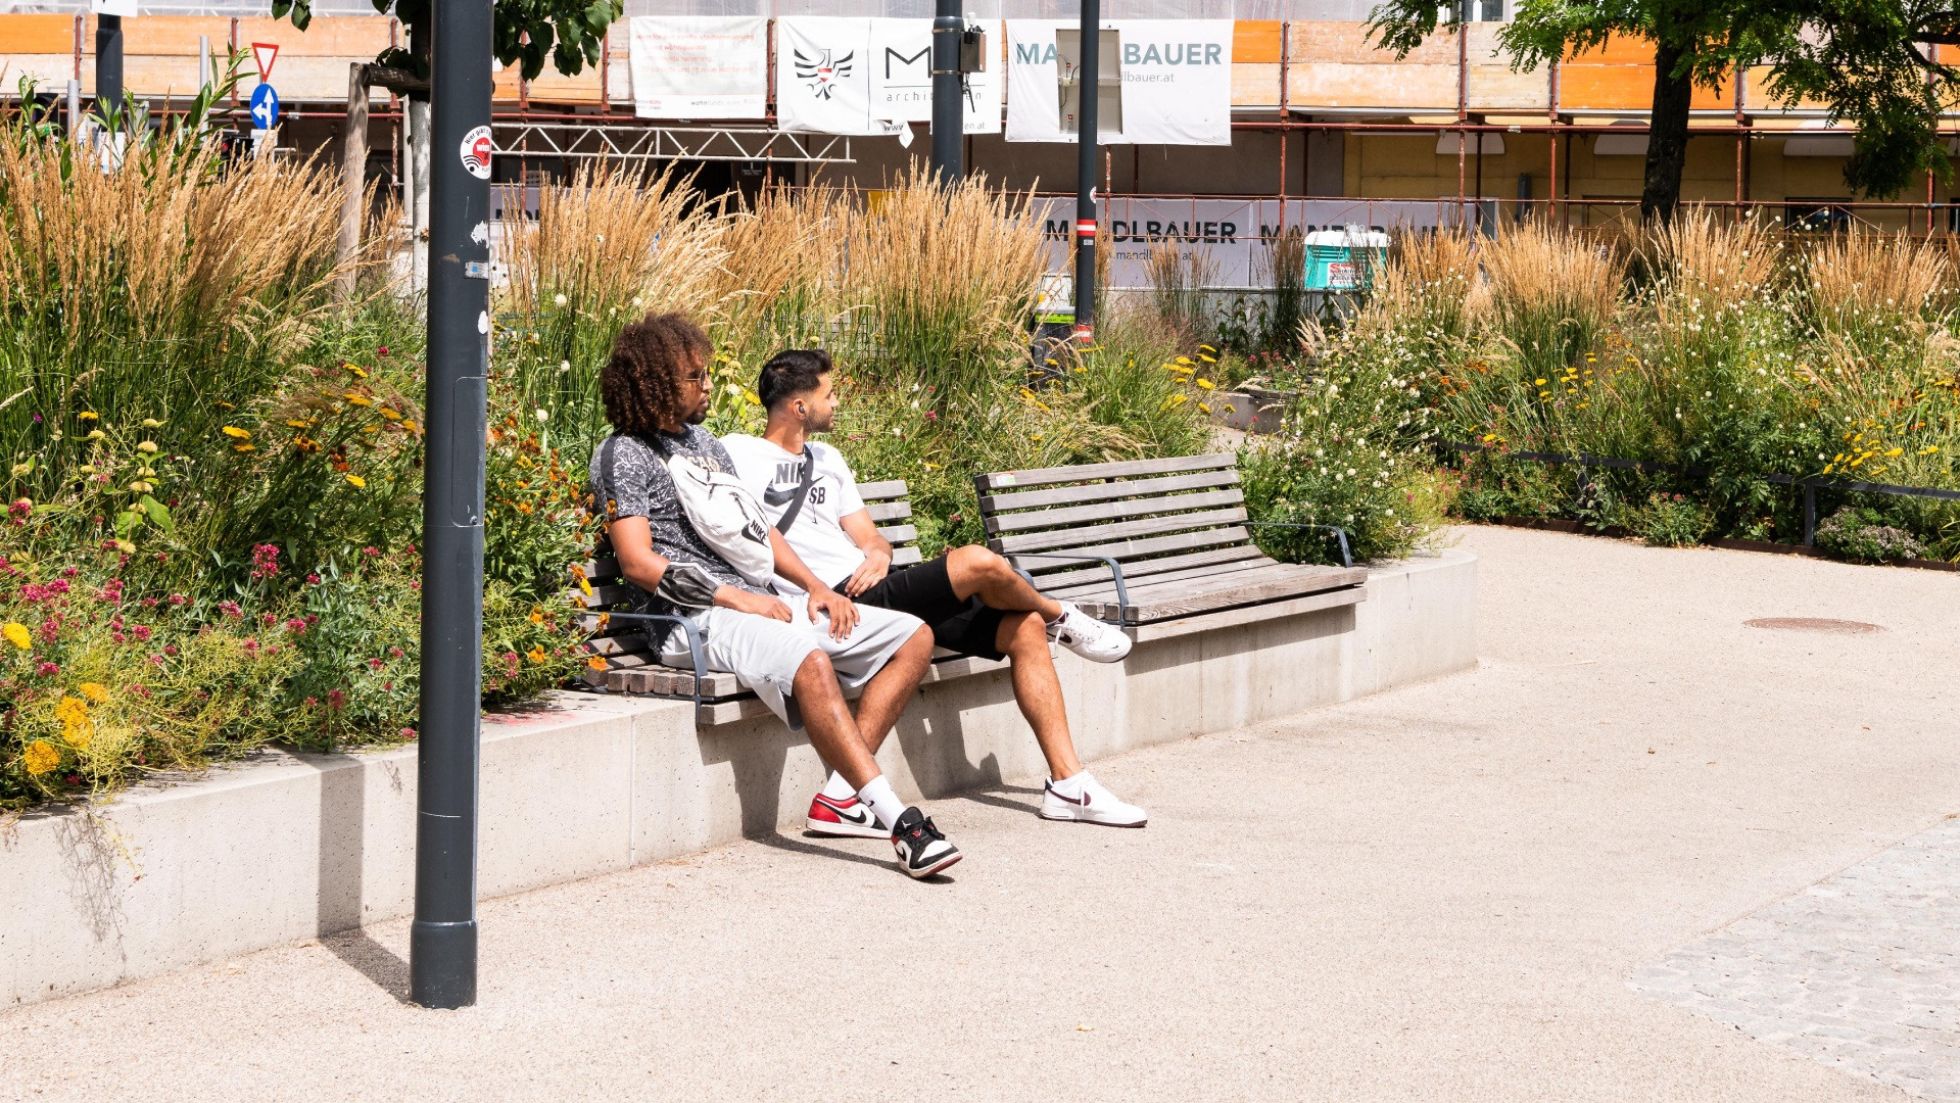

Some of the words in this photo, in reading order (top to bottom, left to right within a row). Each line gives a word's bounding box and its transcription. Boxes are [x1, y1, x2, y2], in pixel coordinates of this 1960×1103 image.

[1016, 43, 1222, 66] MABAUER
[1046, 220, 1237, 244] MDLBAUER
[775, 462, 806, 484] NIK
[809, 486, 826, 504] SB
